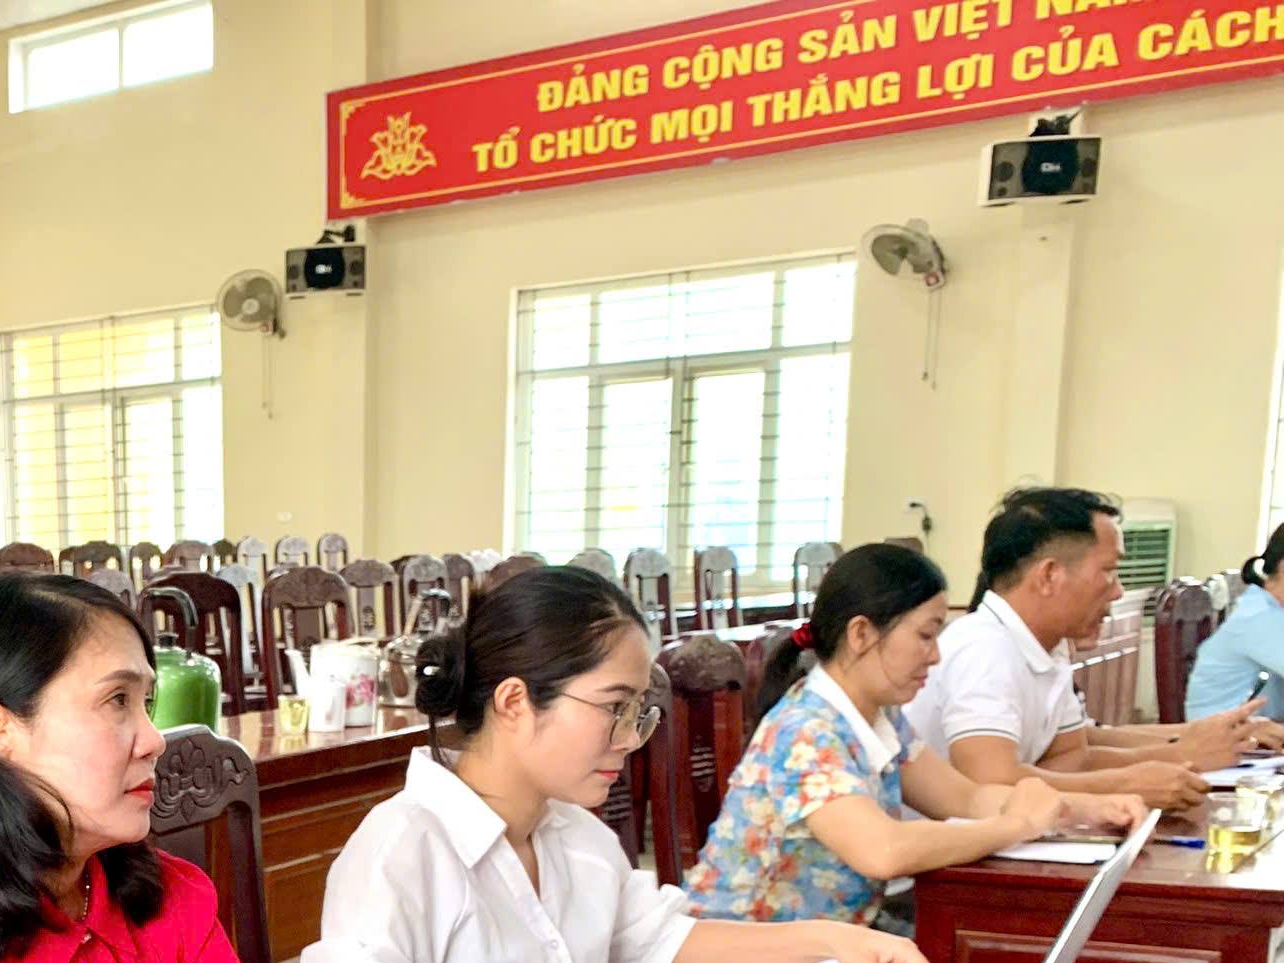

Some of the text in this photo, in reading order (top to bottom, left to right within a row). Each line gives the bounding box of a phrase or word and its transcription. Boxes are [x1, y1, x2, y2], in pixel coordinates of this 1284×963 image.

[472, 4, 1284, 172] TỔ CHỨC MỌI THẮNG LỢI CỦA CÁCH
[536, 63, 650, 112] ĐẢNG
[662, 38, 784, 90] CỘNG
[797, 9, 898, 64] SẢN
